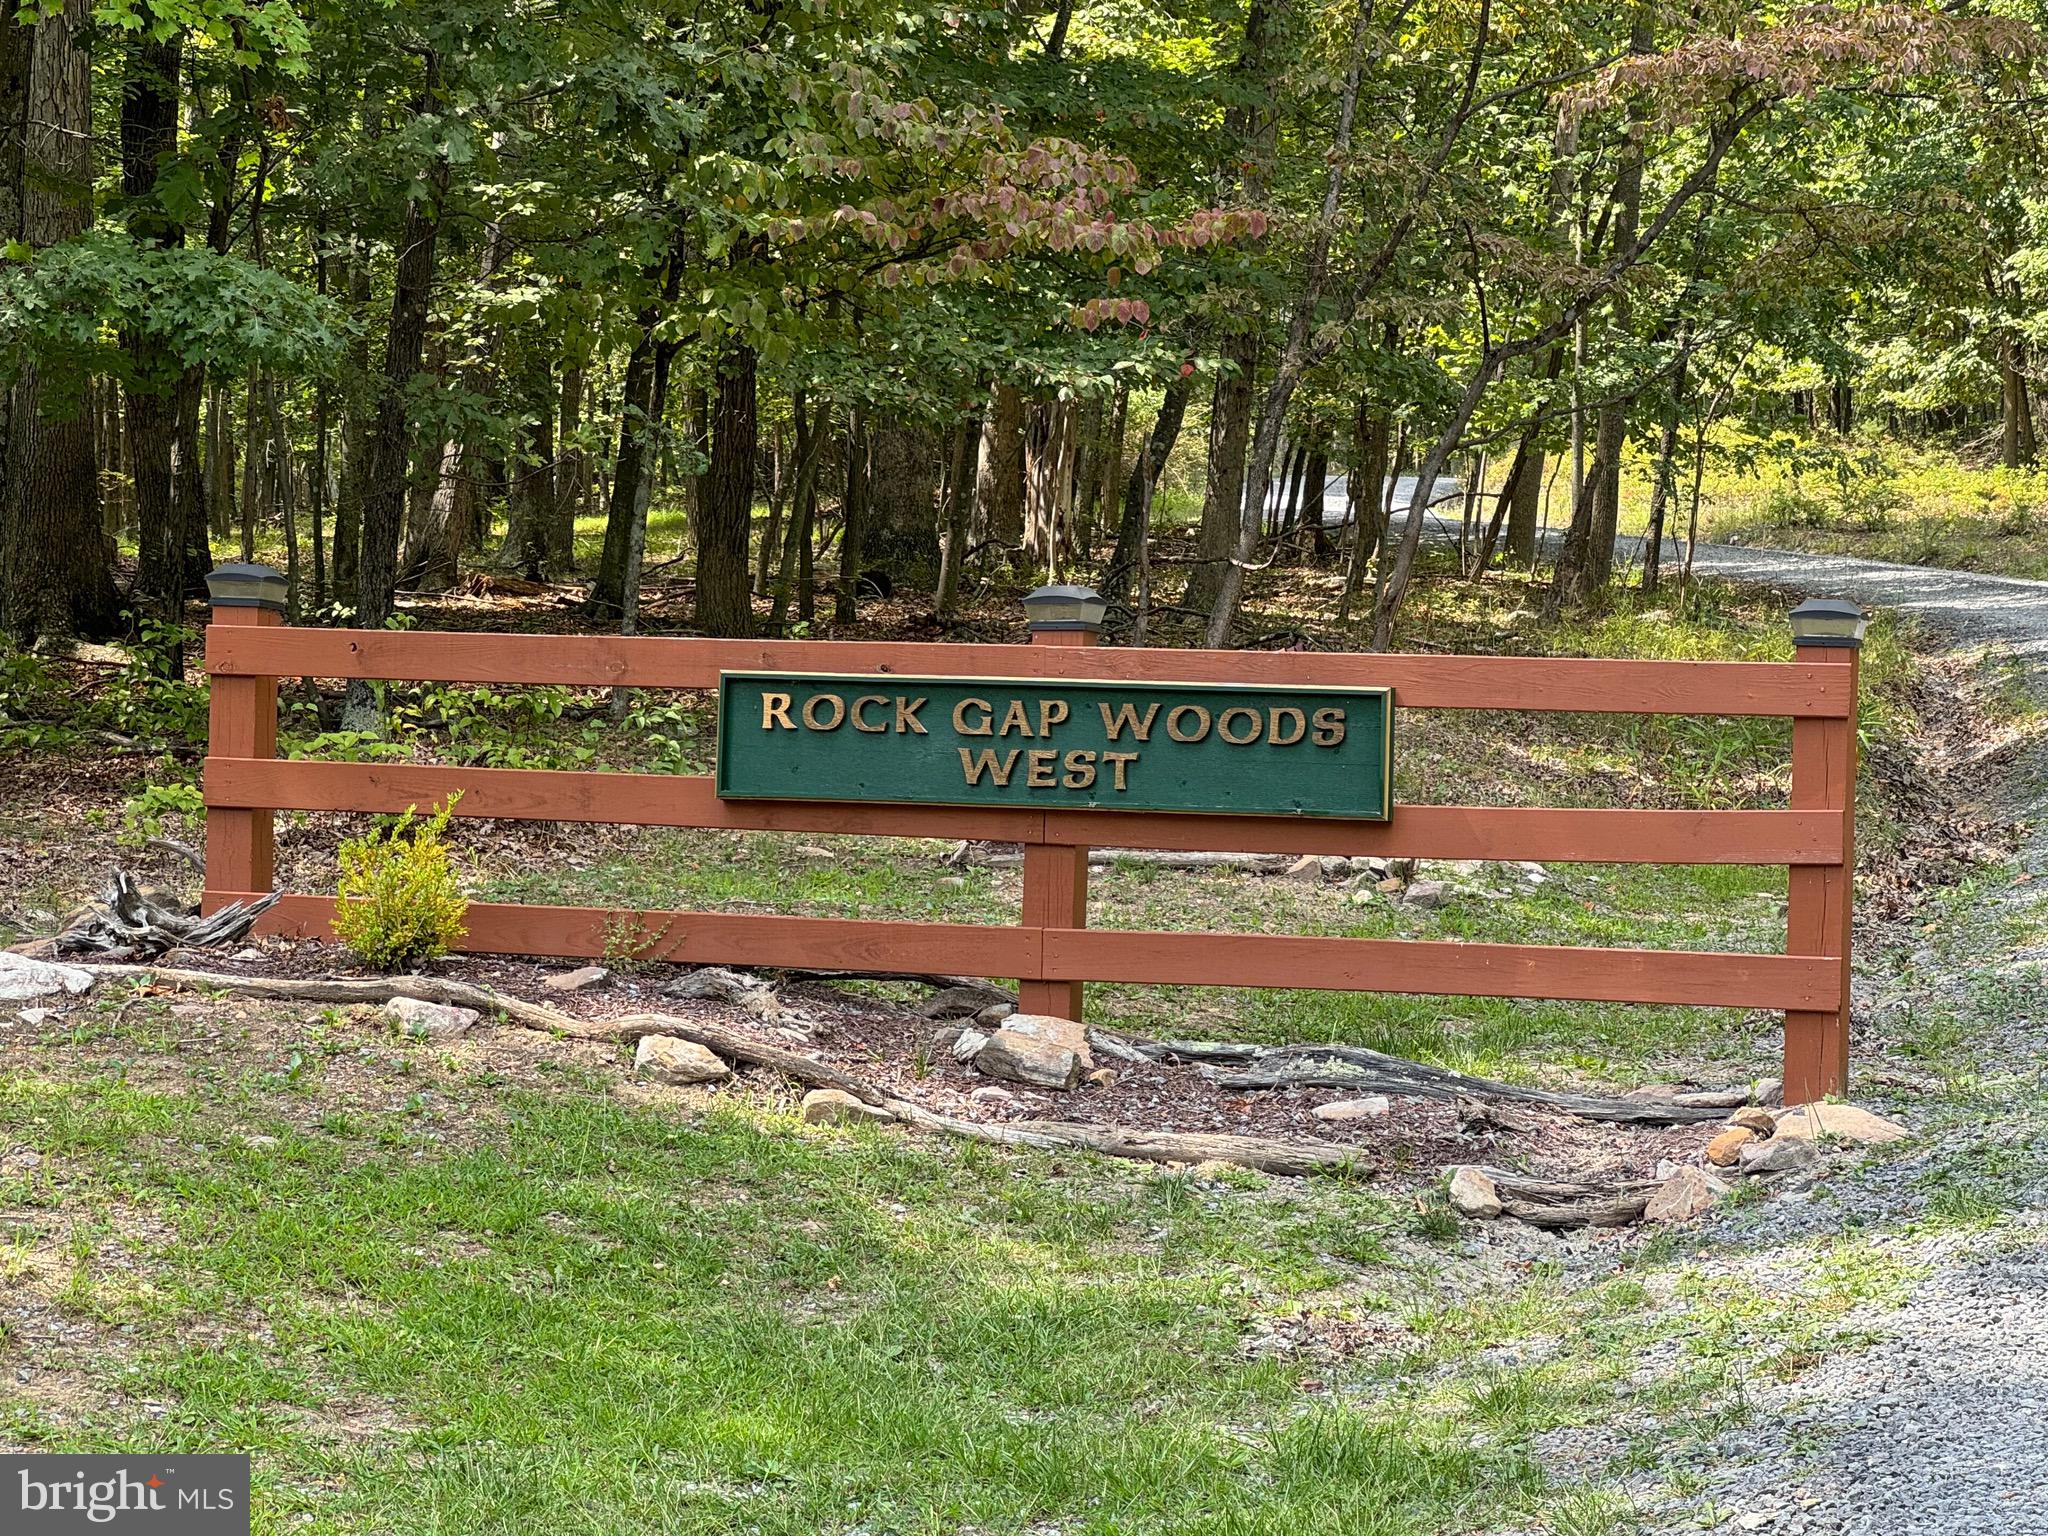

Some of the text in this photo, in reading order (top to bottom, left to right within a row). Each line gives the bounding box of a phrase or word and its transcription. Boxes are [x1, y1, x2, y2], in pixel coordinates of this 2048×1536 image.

[761, 692, 1347, 747] ROCK GAP WOODS
[957, 747, 1139, 791] WEST
